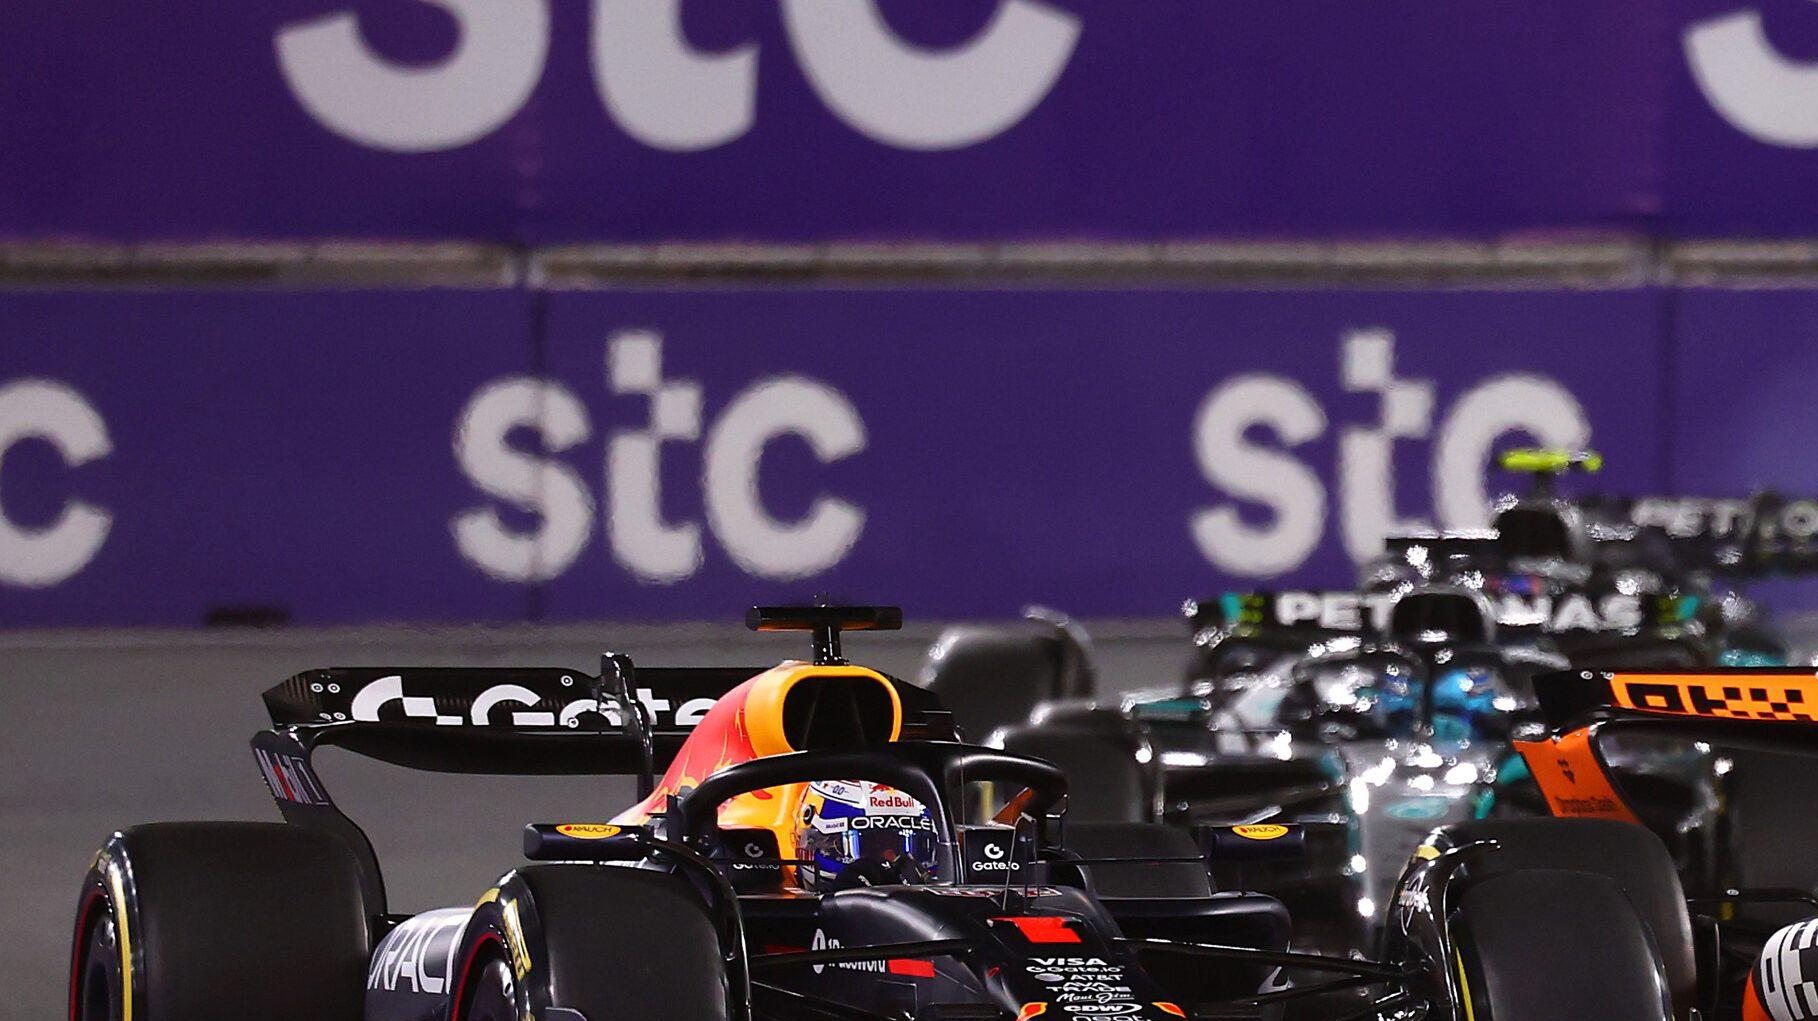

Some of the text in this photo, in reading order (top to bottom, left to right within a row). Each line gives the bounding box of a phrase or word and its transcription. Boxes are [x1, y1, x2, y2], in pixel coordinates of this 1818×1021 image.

[454, 330, 866, 581] stc
[1274, 593, 1642, 633] PETNAS
[869, 796, 915, 809] Red Bull
[573, 825, 613, 833] RAUCH
[851, 815, 933, 830] ORACLE
[972, 860, 1020, 871] Gate.io
[1027, 957, 1108, 966] VISA
